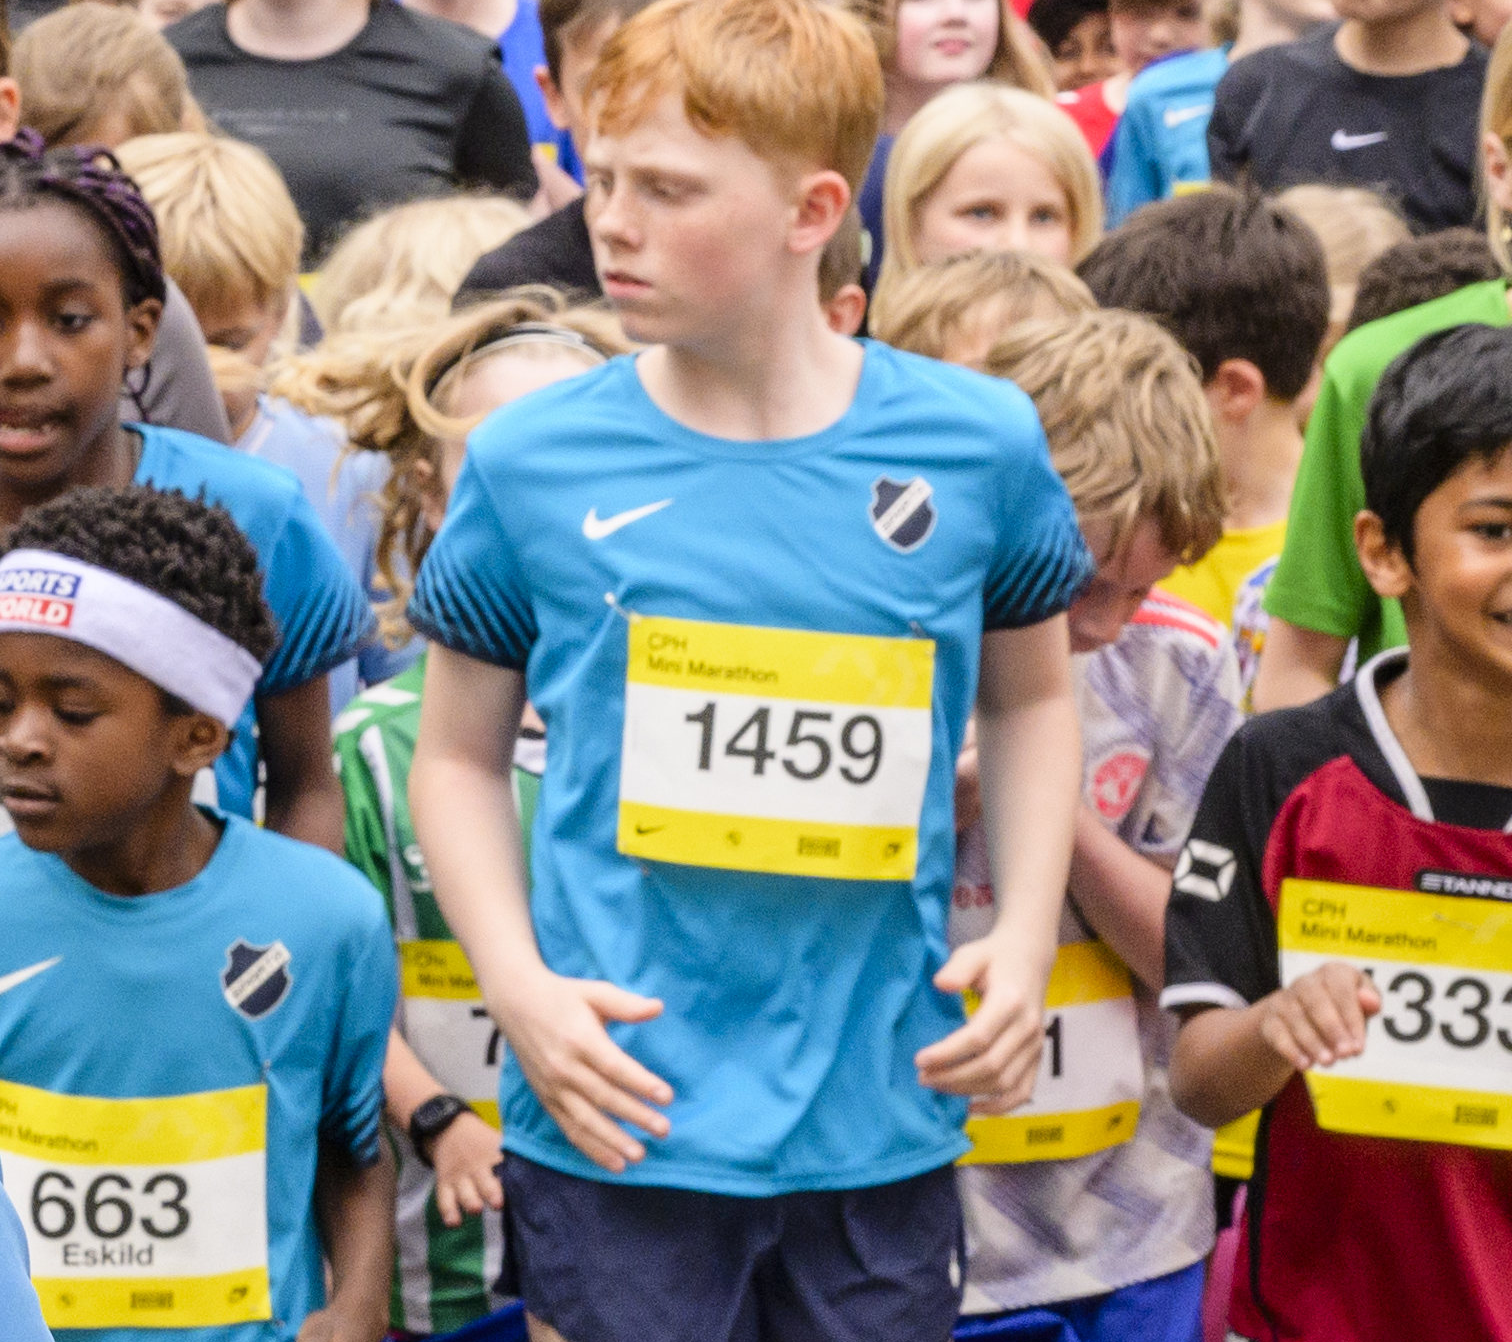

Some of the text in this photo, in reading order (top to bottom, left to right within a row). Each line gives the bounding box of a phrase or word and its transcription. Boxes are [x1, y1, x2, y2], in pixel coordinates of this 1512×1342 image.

[647, 632, 688, 652] CPH
[648, 655, 779, 684] Mini Marathon
[684, 700, 885, 786] 1459
[1301, 899, 1347, 919] CPH
[1300, 921, 1438, 953] Mini Marathon
[17, 1125, 98, 1153] Marathon
[31, 1170, 191, 1240] 663
[62, 1243, 155, 1268] Eskild
